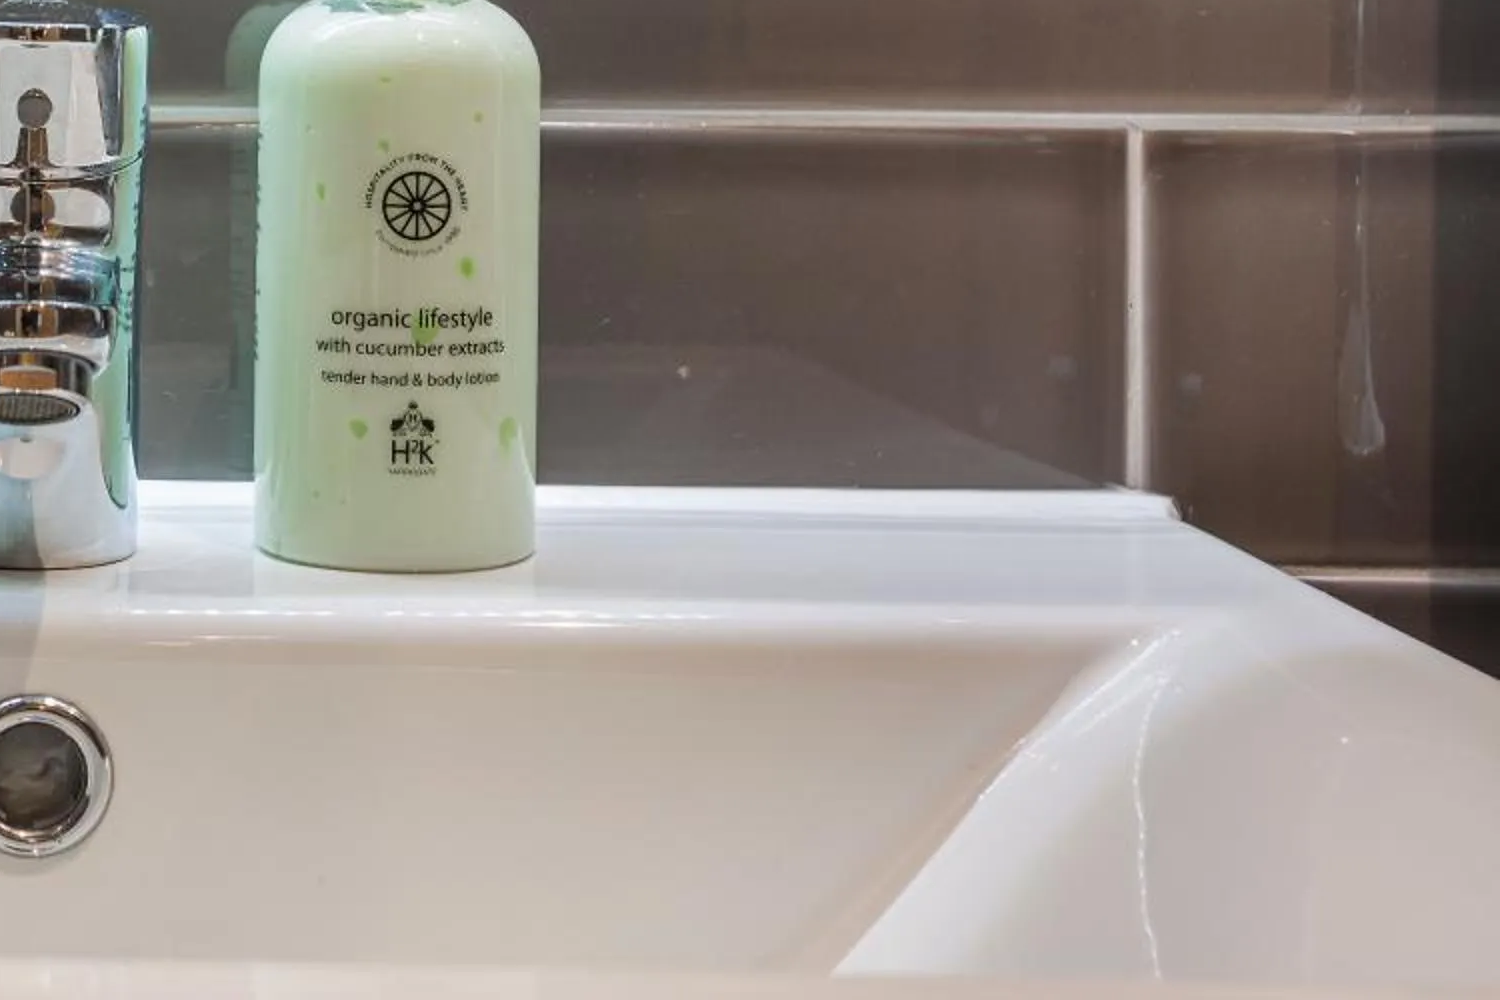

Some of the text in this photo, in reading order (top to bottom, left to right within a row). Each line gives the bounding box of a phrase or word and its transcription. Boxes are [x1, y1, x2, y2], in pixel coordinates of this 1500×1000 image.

[407, 152, 439, 165] FROM
[331, 306, 494, 333] organic lifestyle
[315, 336, 505, 358] with cucumber extracts
[320, 370, 500, 392] tender hand & body lotion
